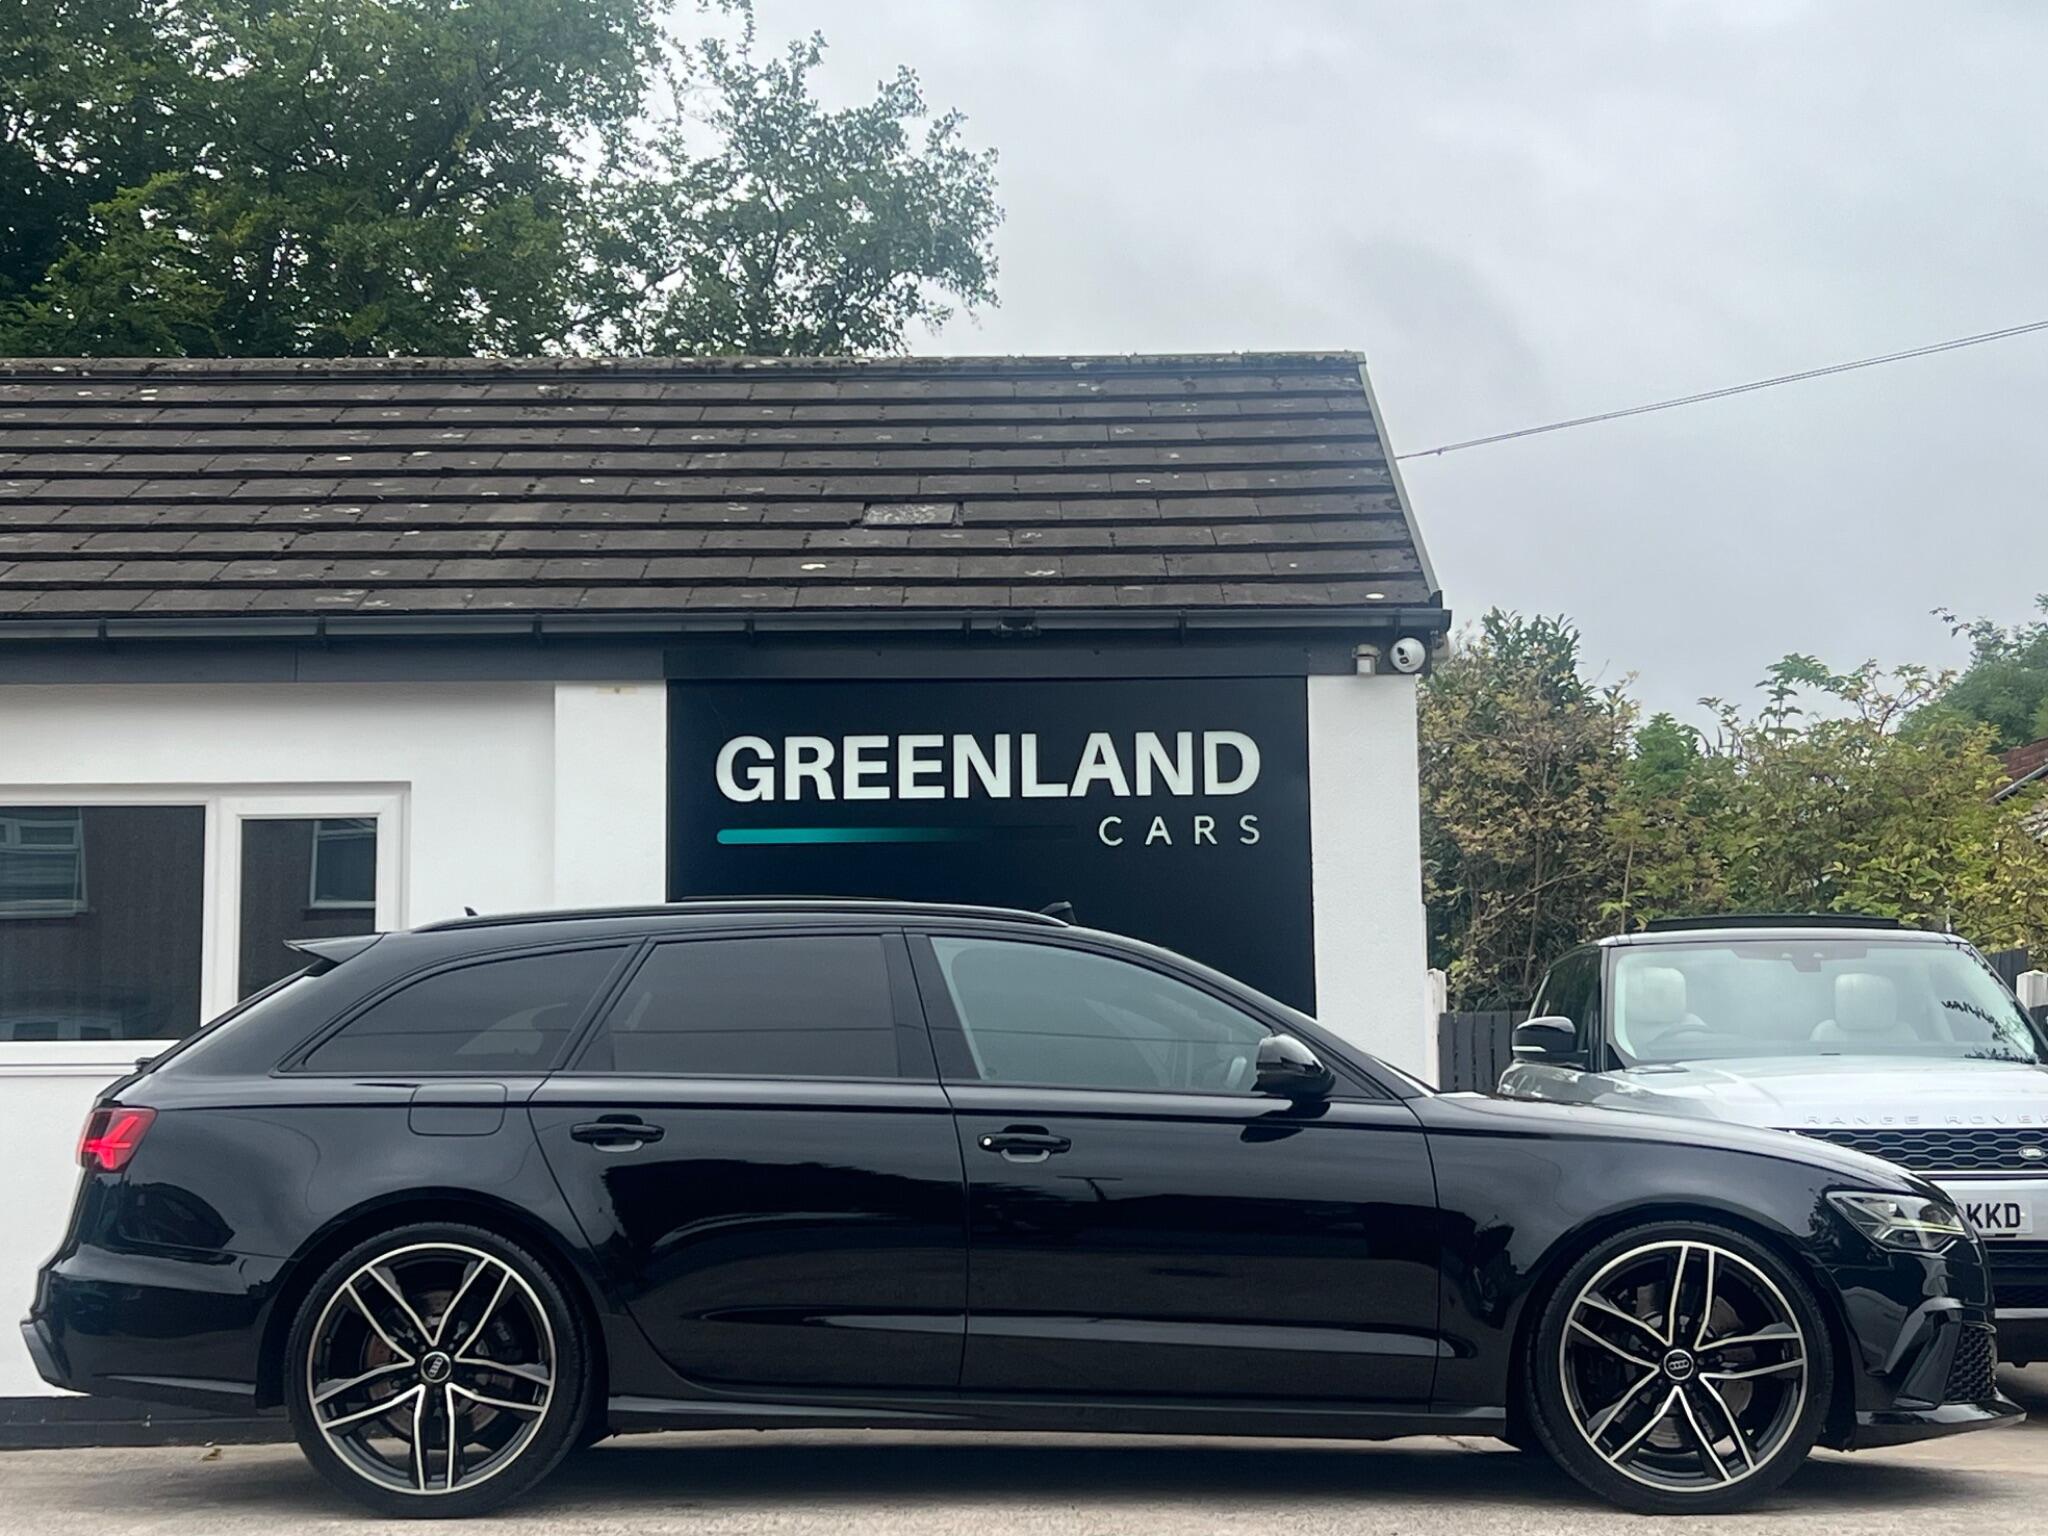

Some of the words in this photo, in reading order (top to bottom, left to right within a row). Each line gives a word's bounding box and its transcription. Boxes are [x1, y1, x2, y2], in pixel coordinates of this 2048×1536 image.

[715, 730, 1261, 802] GREENLAND
[1097, 814, 1261, 846] CARS
[1804, 1113, 1921, 1125] RANGE
[1966, 1202, 2021, 1228] KKD
